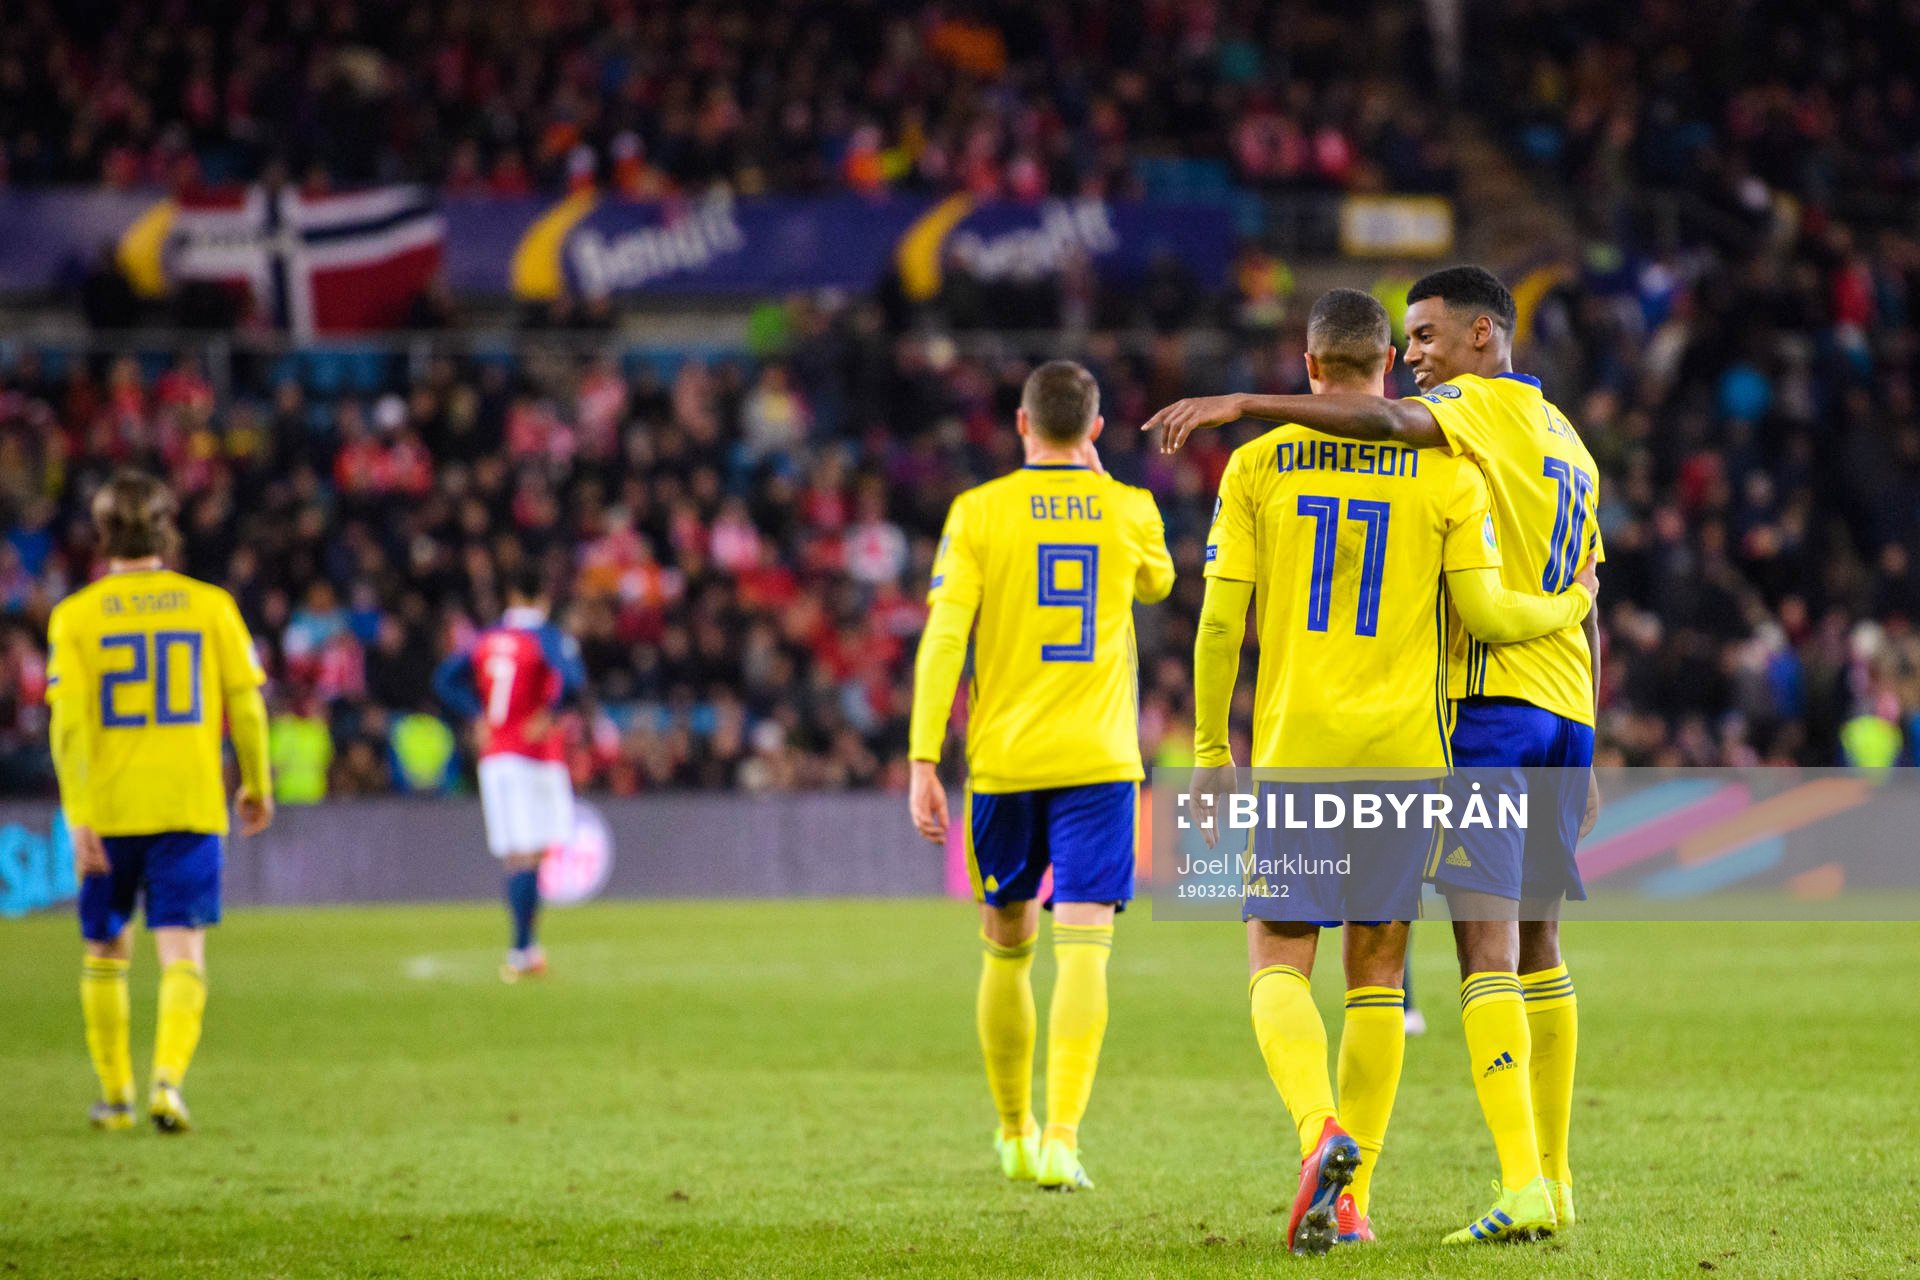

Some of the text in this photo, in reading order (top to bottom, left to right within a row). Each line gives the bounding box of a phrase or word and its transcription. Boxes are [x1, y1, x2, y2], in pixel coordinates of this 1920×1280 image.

[1030, 494, 1102, 520] BERG
[1276, 440, 1419, 478] QUAISON
[1037, 543, 1099, 663] 9
[1297, 494, 1391, 637] 11
[100, 631, 202, 727] 20
